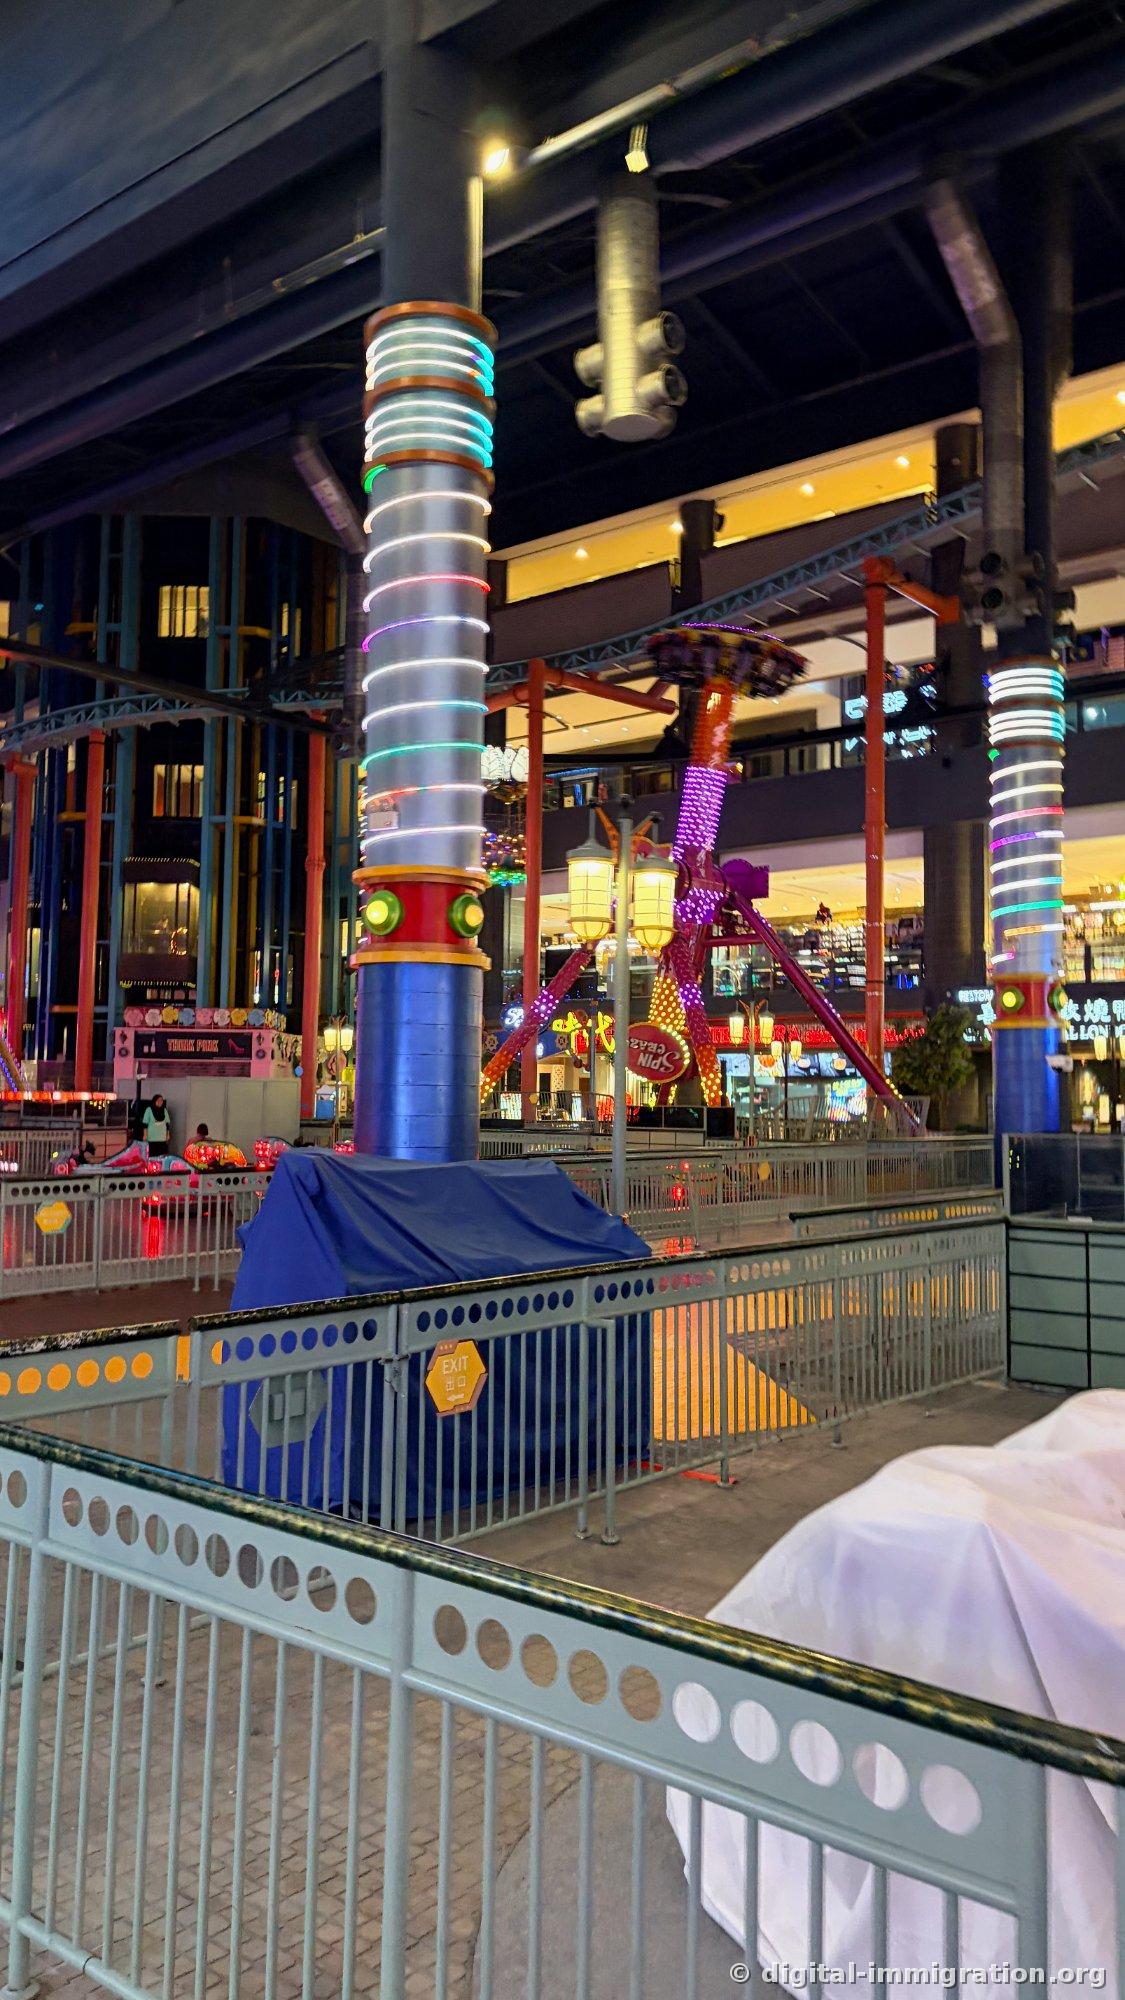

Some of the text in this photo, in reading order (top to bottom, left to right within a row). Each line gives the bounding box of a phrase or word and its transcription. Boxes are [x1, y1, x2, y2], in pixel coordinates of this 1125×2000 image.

[637, 1051, 680, 1073] SPIN
[442, 1355, 469, 1375] EXIT
[446, 1375, 466, 1392] 出口
